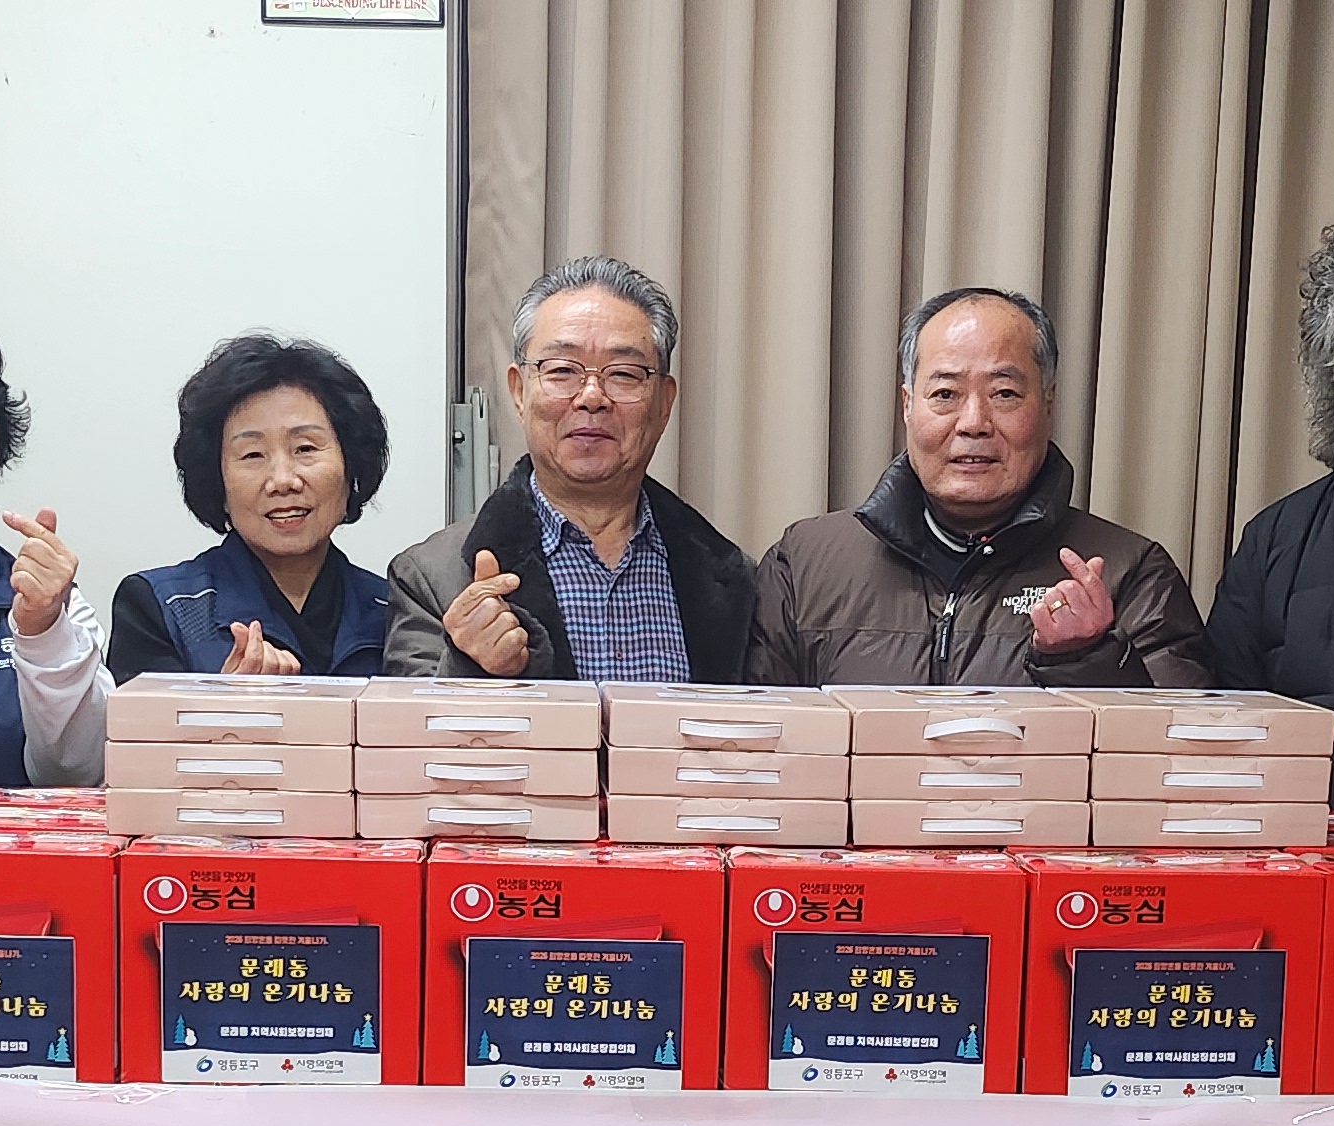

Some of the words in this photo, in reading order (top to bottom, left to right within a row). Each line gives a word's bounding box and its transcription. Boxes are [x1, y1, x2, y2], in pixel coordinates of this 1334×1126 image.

[380, 0, 401, 8] LIFE
[1022, 587, 1047, 596] THE
[188, 884, 255, 910] 농심
[494, 892, 560, 918] 농심
[797, 896, 863, 922] 농심
[1099, 899, 1164, 924] 농심
[240, 959, 308, 977] 문래동
[545, 975, 611, 994] 문래동
[850, 969, 916, 988] 문래동
[179, 982, 249, 1001] 사랑의
[263, 983, 353, 1002] 온기나눔
[1149, 985, 1213, 1003] 문래동
[485, 999, 553, 1017] 사랑의
[567, 1000, 655, 1019] 온기나눔
[789, 992, 857, 1011] 사랑의
[871, 993, 959, 1013] 온기나눔
[1088, 1009, 1156, 1027] 사랑의
[1169, 1009, 1256, 1027] 온기나눔
[221, 1027, 248, 1036] 문래동
[251, 1027, 333, 1037] 지역사회보장협의체
[524, 1043, 551, 1052] 문래동
[554, 1043, 635, 1054] 지역사회보장협의체
[827, 1036, 854, 1045] 문래동
[857, 1036, 938, 1047] 지역사회보장협의체
[218, 1060, 258, 1070] 영등포구
[1126, 1052, 1153, 1062] 문래동
[1155, 1052, 1235, 1062] 지역사회보장협의체
[521, 1075, 560, 1086] 영등포구
[824, 1069, 863, 1079] 영등포구
[1122, 1085, 1161, 1095] 영등포구
